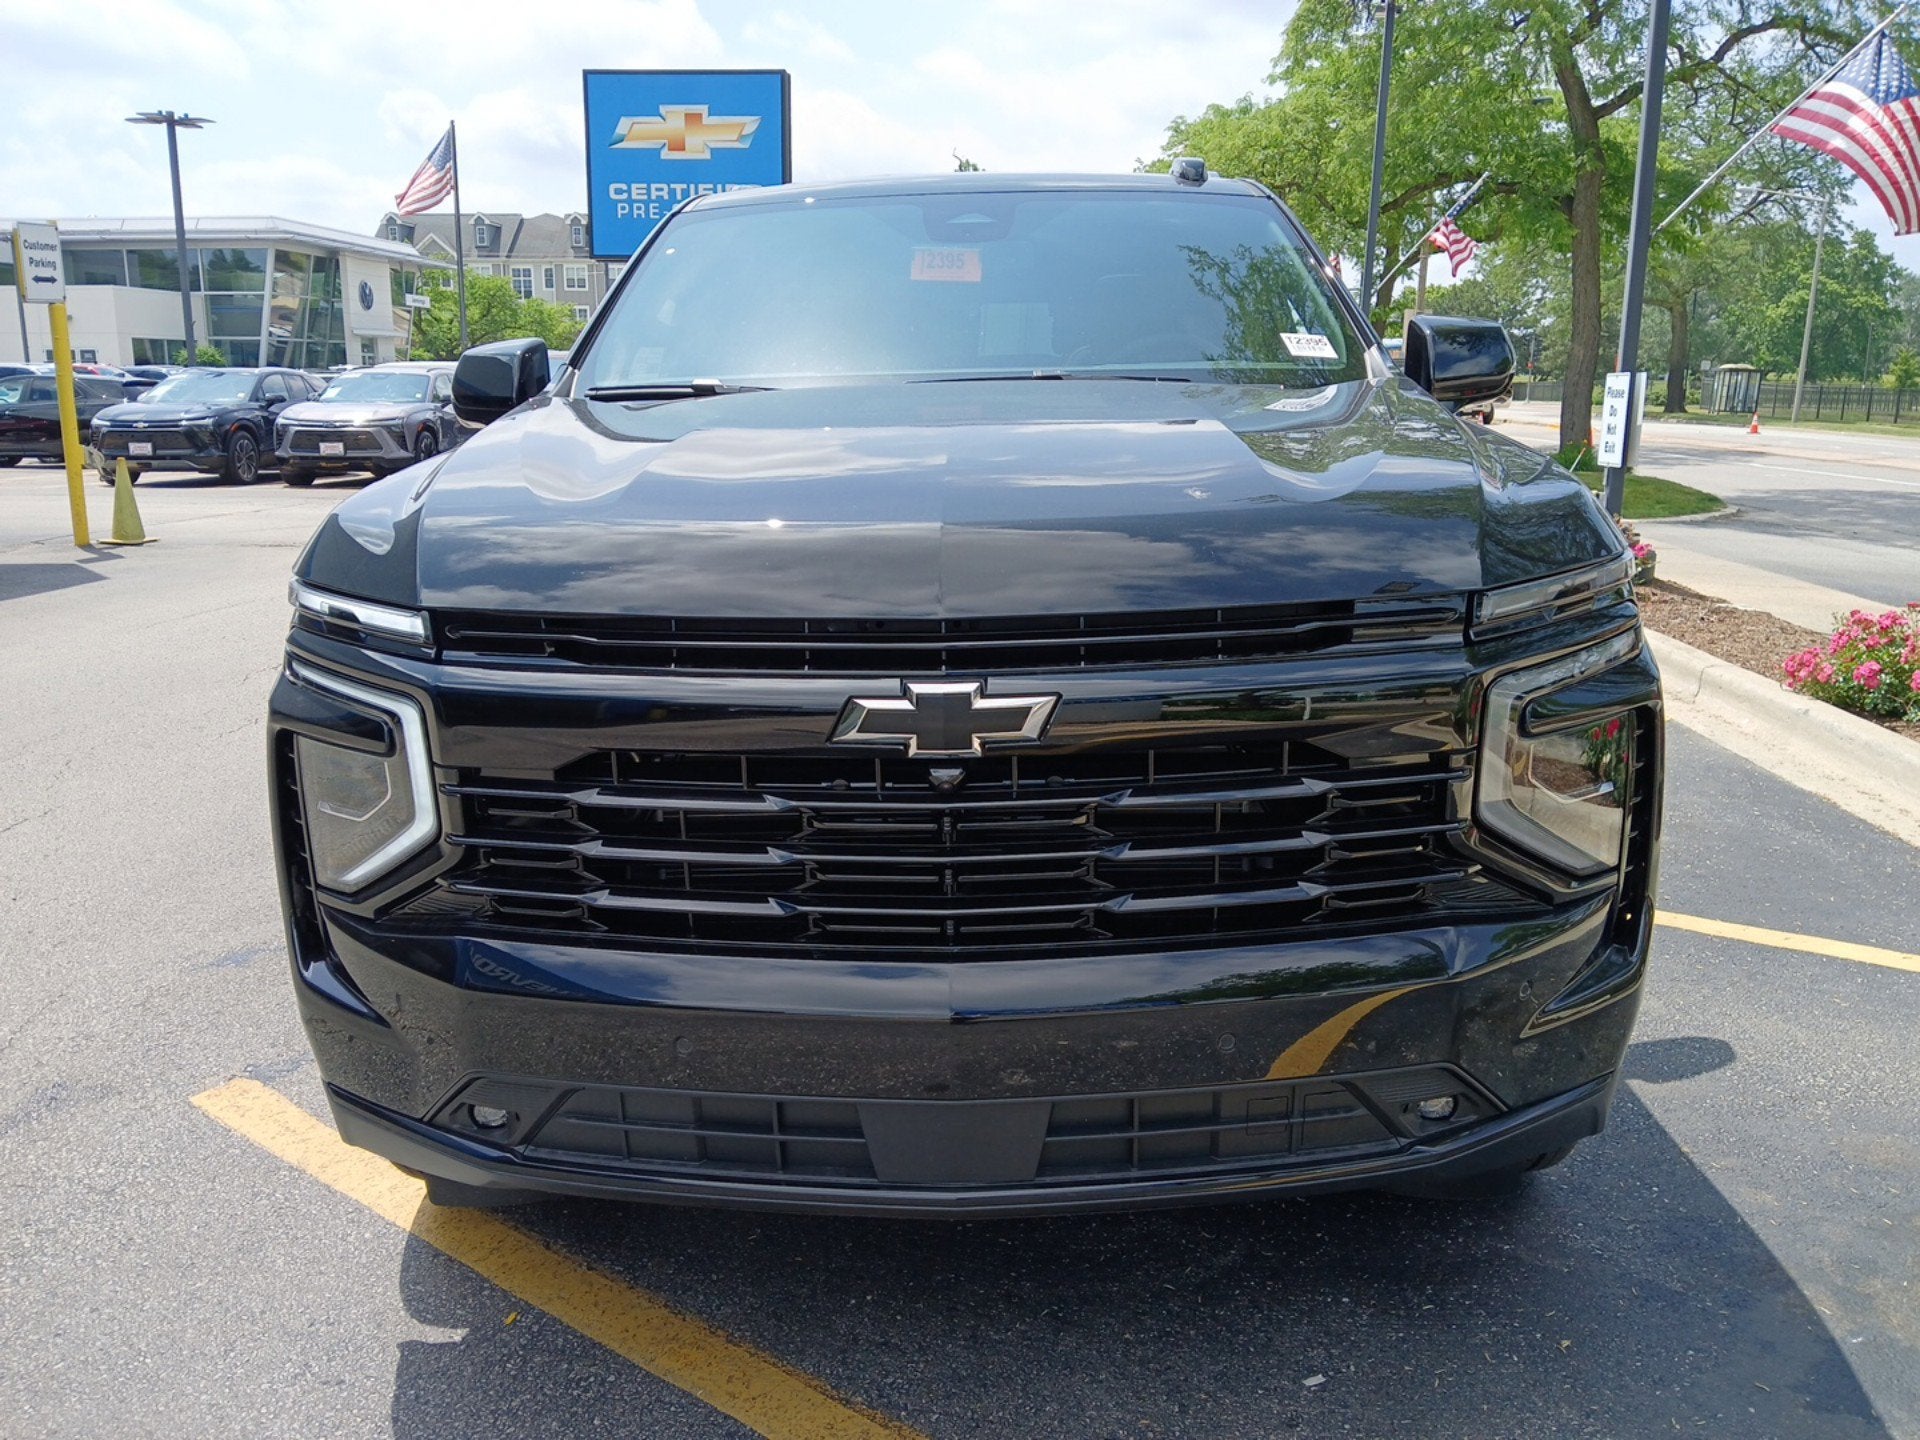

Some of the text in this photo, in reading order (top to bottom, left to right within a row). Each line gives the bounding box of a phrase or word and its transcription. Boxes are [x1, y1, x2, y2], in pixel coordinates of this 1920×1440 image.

[608, 183, 762, 200] CERTIFI
[23, 239, 57, 251] Customer
[29, 257, 57, 271] Parking
[1285, 334, 1328, 346] T2395
[1607, 386, 1625, 398] Please
[1609, 405, 1618, 417] Do
[1607, 423, 1617, 435] Not
[1604, 441, 1616, 453] Exit
